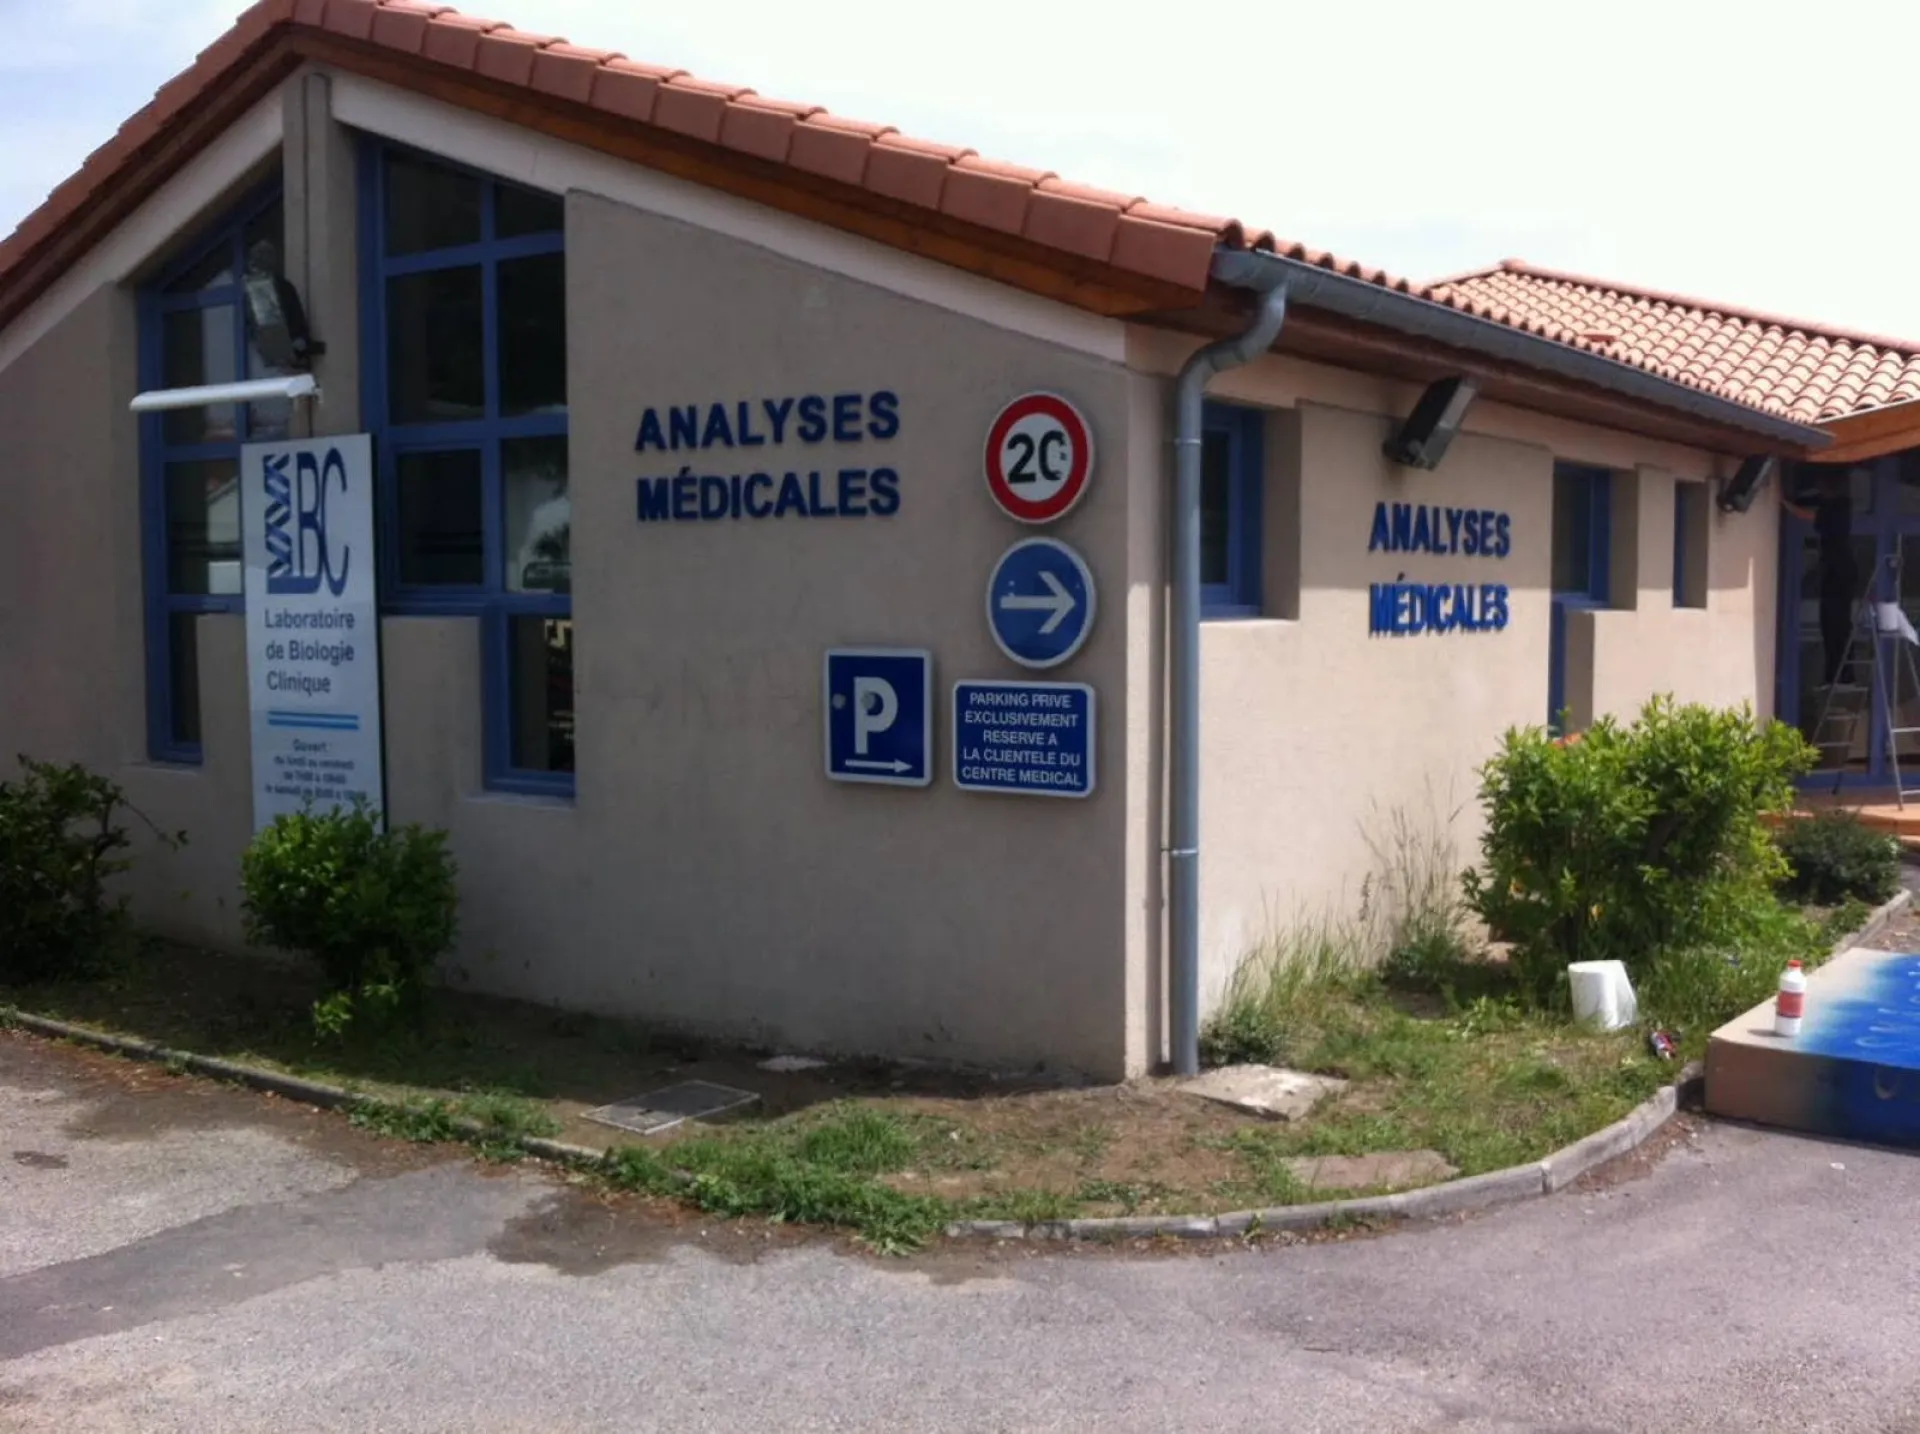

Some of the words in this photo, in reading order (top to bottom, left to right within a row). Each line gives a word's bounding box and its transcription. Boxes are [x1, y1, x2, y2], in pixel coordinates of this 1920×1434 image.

[635, 391, 900, 453] ANALYSES
[637, 466, 901, 521] MÉDICALES
[1368, 502, 1511, 558] ANALYSES
[264, 607, 355, 629] Laboratoire
[1368, 572, 1510, 638] MÉDICALES
[266, 640, 284, 660] de
[289, 640, 355, 666] Biologie
[266, 670, 331, 696] Clinique
[969, 691, 1029, 707] PARKING
[1031, 693, 1073, 708] PRIVE
[853, 676, 899, 754] P
[964, 709, 1079, 727] EXCLUSIVEMENT
[983, 729, 1045, 746] RESERVE
[1047, 732, 1059, 747] A
[963, 747, 980, 761] LA
[983, 748, 1057, 765] CLIENTELE
[1060, 752, 1081, 767] DU
[961, 766, 1016, 782] CENTRE
[1019, 769, 1083, 786] MEDICAL
